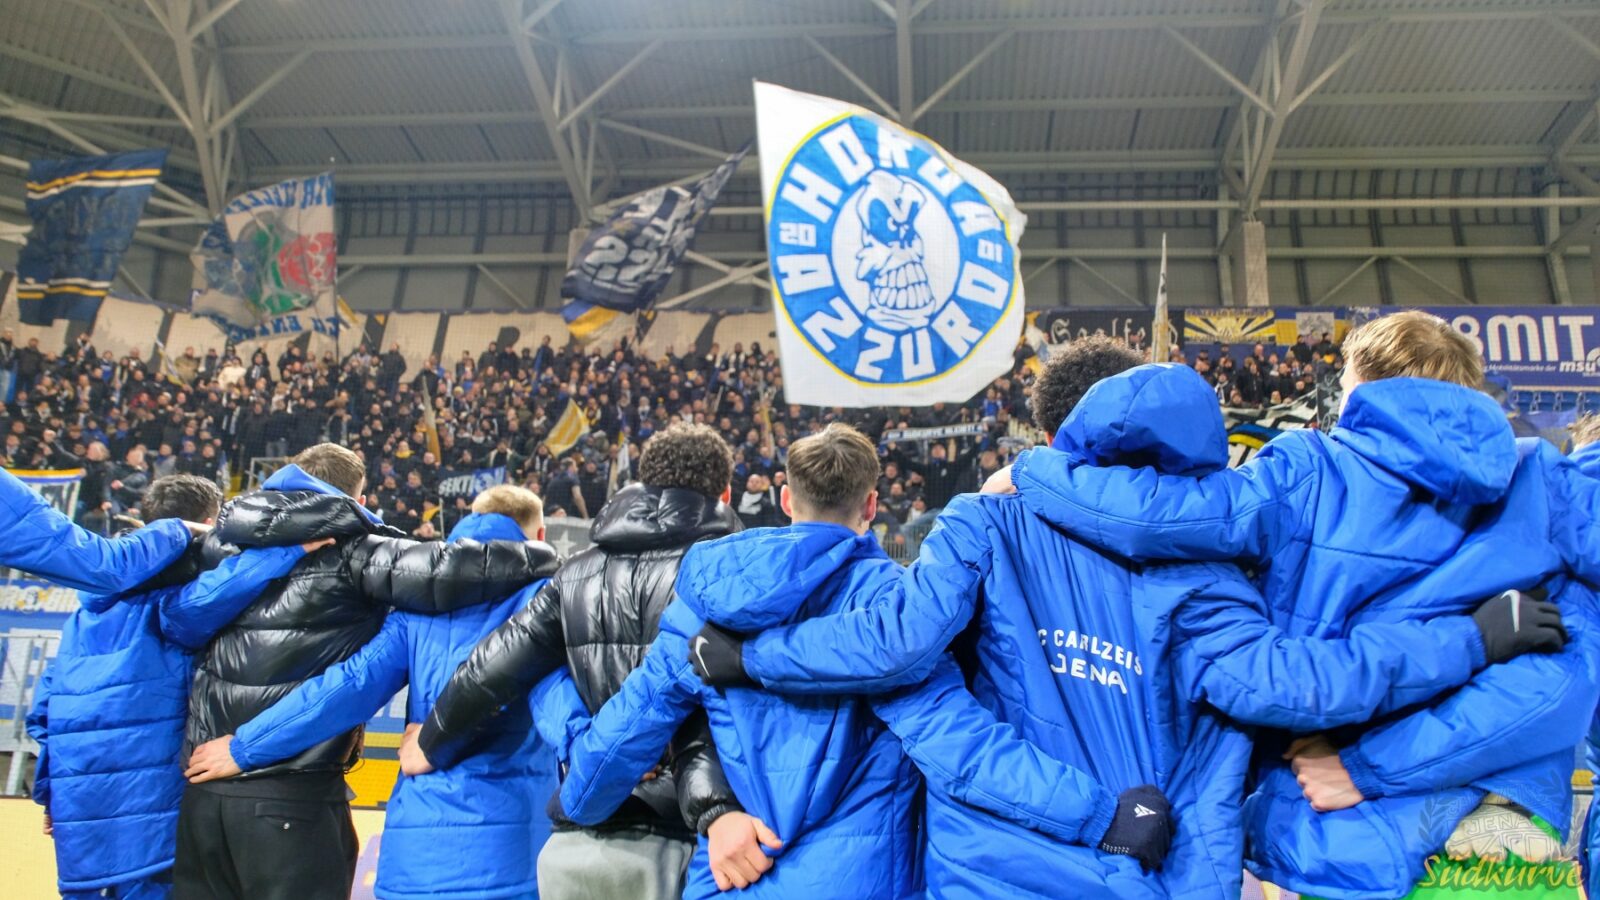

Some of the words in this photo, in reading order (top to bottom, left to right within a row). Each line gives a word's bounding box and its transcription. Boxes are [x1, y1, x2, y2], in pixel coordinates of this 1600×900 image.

[779, 222, 817, 247] 20
[776, 253, 1010, 381] AZZURO
[1051, 317, 1178, 350] Salfed
[1559, 361, 1596, 373] msu
[1050, 653, 1127, 694] JENA
